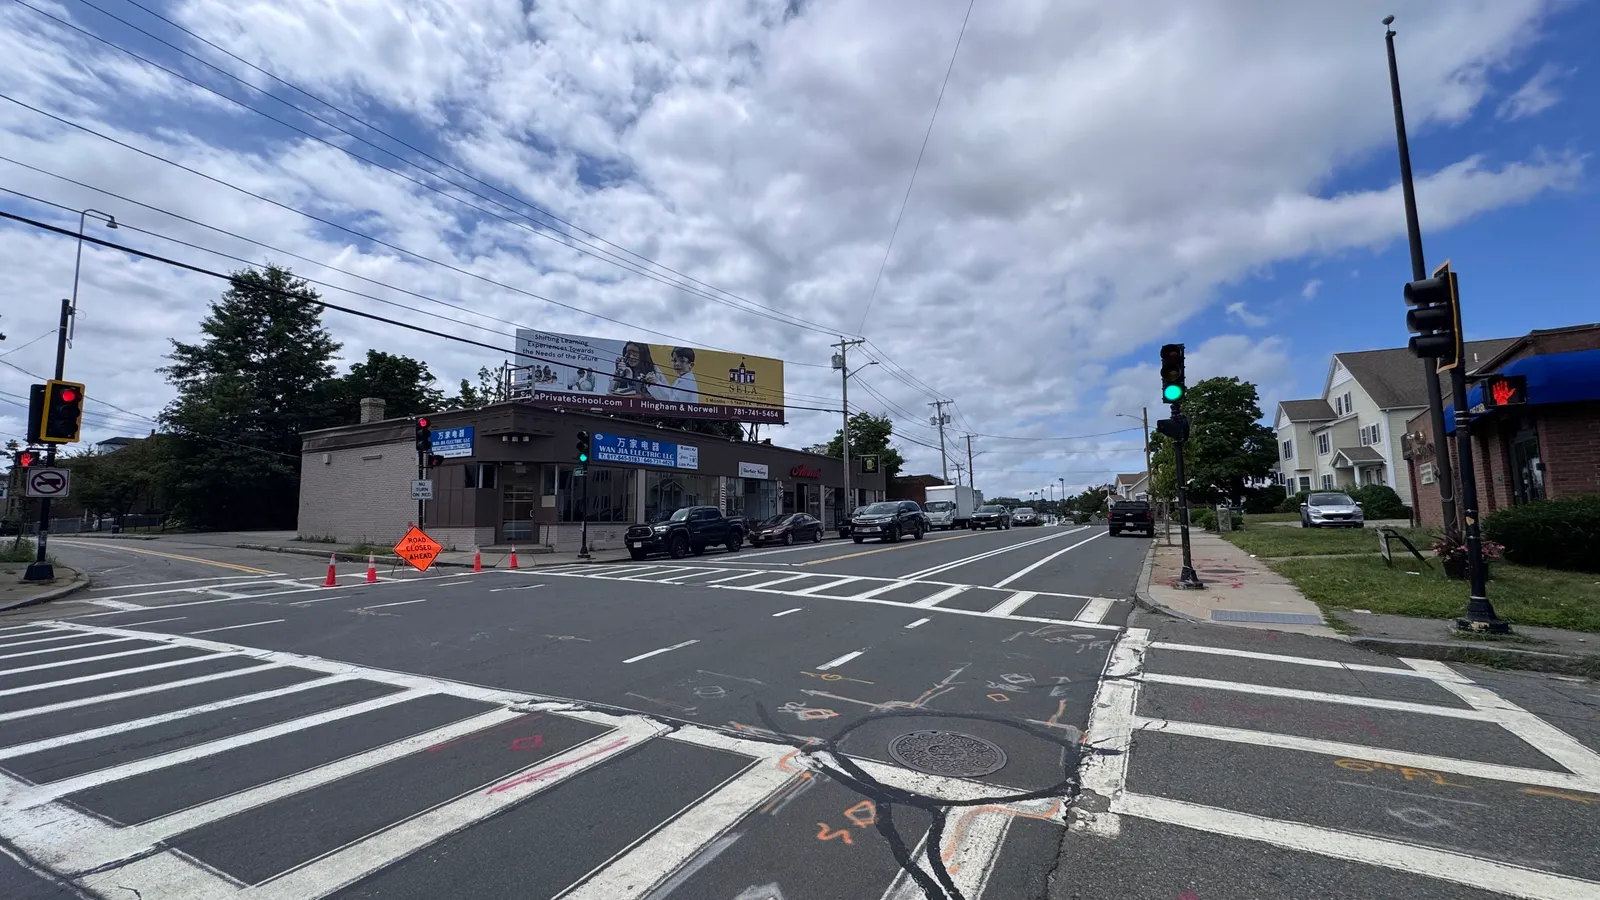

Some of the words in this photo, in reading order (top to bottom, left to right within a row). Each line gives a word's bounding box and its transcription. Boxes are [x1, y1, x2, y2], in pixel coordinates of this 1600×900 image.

[534, 334, 560, 344] Shifting
[561, 338, 588, 346] Learning
[528, 341, 567, 351] Experiences
[569, 346, 594, 354] Towards
[728, 384, 758, 394] SELA
[640, 400, 677, 411] Hingham
[680, 404, 685, 412] &
[688, 404, 718, 414] Norwell
[734, 408, 778, 418] 781-741-5454
[438, 428, 464, 440] 万家电器
[617, 438, 660, 452] 万家电器
[599, 446, 616, 454] WAN
[630, 448, 661, 458] ELECTRIC
